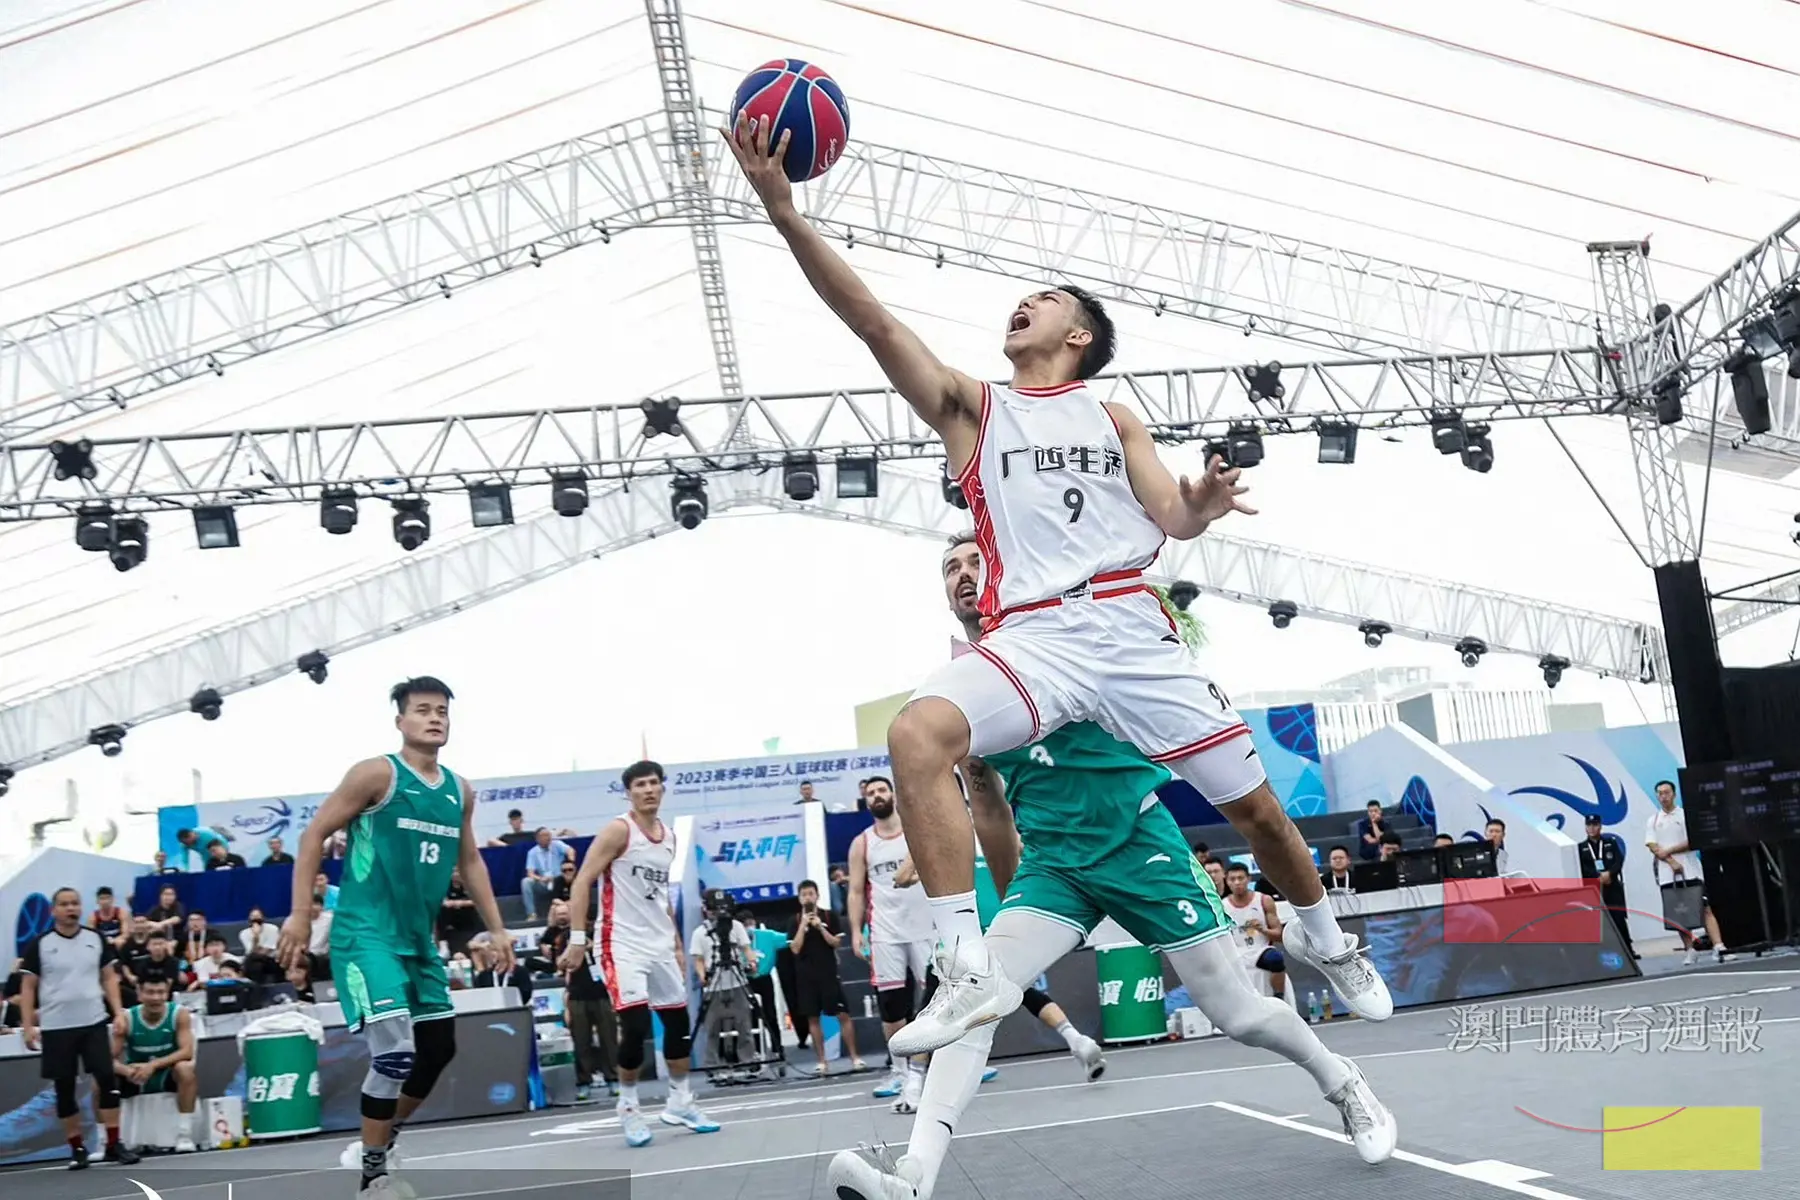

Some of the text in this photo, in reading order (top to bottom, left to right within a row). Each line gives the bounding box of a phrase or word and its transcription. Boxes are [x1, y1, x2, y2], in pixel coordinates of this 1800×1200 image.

[1063, 487, 1085, 524] 9
[418, 840, 441, 865] 13
[1177, 899, 1199, 926] 3
